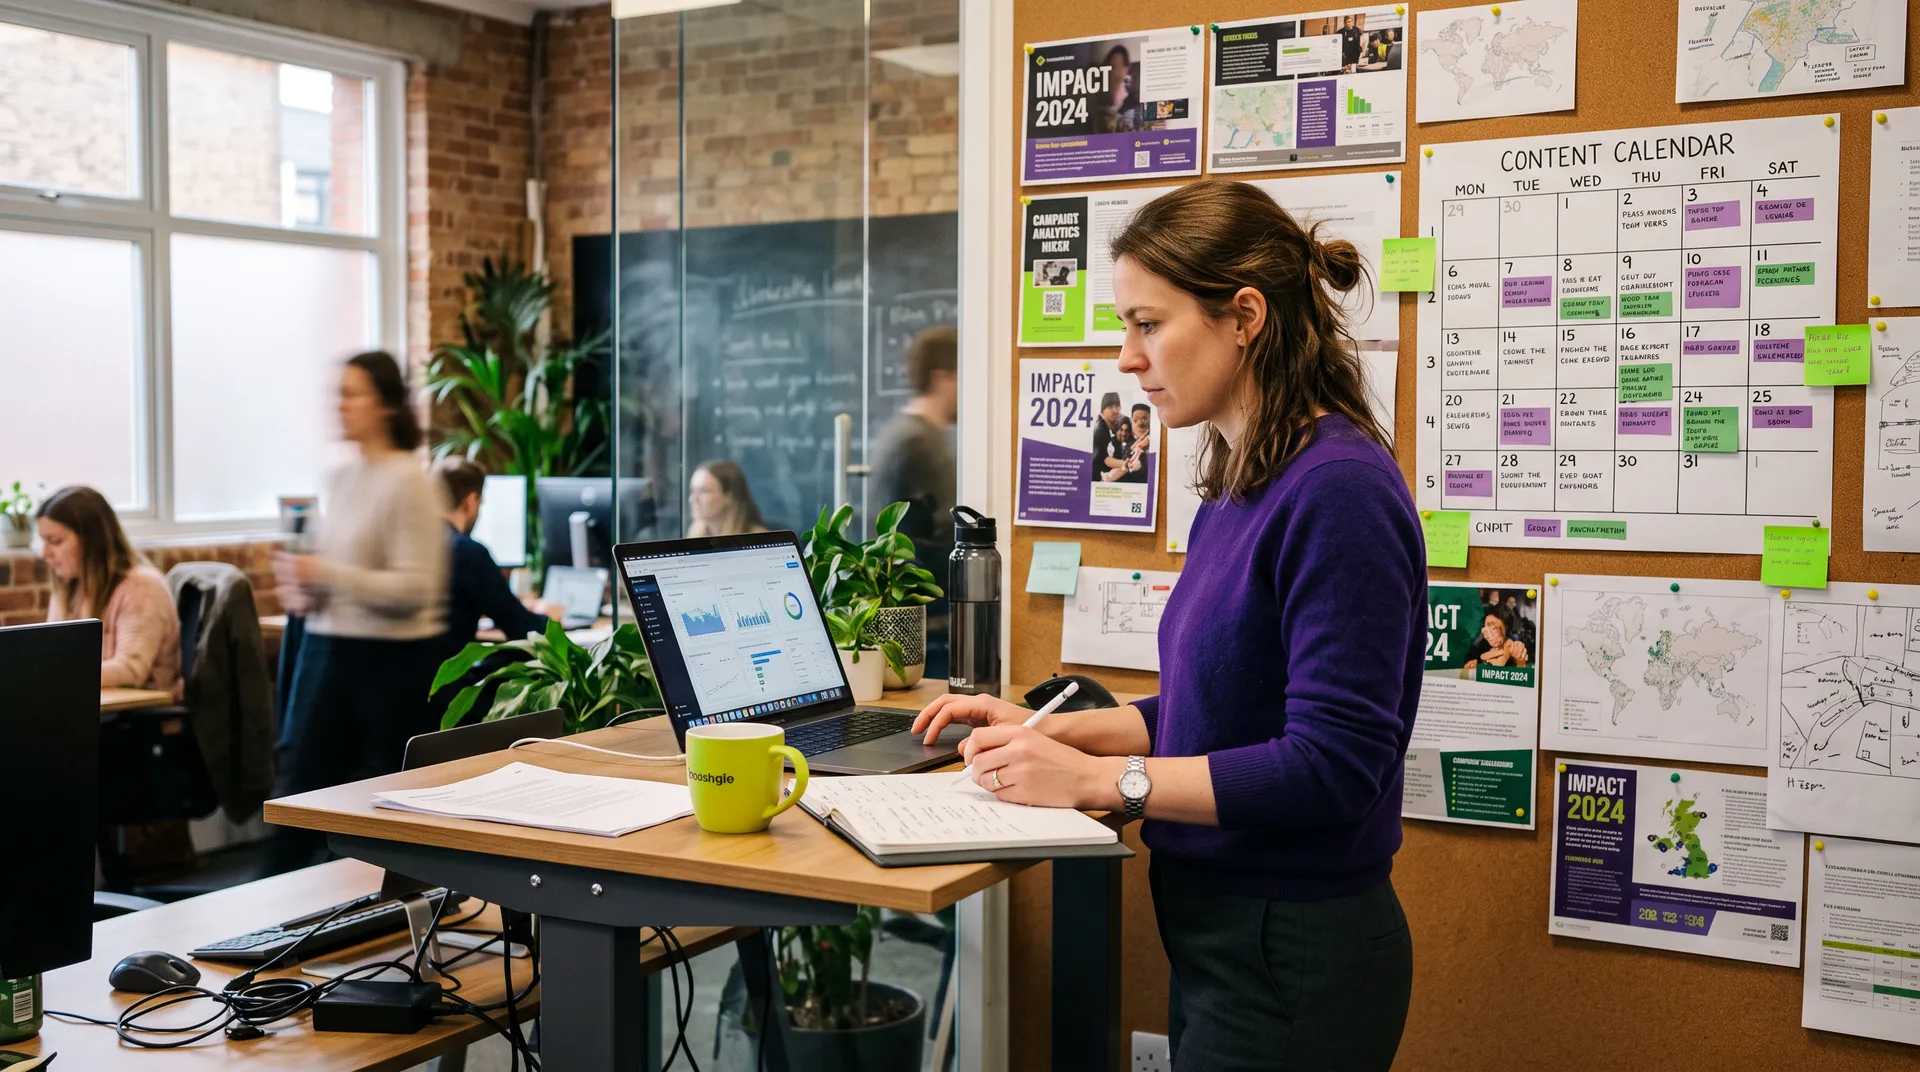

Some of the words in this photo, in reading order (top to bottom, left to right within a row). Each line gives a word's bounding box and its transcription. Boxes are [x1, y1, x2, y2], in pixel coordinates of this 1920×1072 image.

[1036, 66, 1112, 98] IMPACT
[1036, 98, 1088, 127] 2024
[1501, 143, 1602, 172] CONTENT
[1614, 132, 1735, 163] CALENDAR
[1455, 183, 1485, 196] MON
[1513, 178, 1540, 192] TUE
[1570, 175, 1601, 188] WED
[1632, 171, 1661, 183] THU
[1701, 166, 1725, 180] FRI
[1768, 160, 1798, 174] SAT
[1448, 204, 1464, 217] 29
[1503, 200, 1521, 213] 30
[1623, 192, 1633, 205] 2
[1687, 188, 1698, 202] 3
[1756, 184, 1768, 197] 4
[1033, 226, 1080, 240] ANALYTICS
[1448, 265, 1458, 277] 6
[1505, 262, 1513, 274] 7
[1563, 258, 1572, 271] 8
[1622, 255, 1632, 269] 9
[1687, 253, 1701, 265] 10
[1758, 250, 1767, 261] 11
[1428, 291, 1436, 303] 2
[1446, 332, 1460, 345] 13
[1503, 331, 1516, 343] 14
[1562, 329, 1575, 342] 15
[1621, 328, 1636, 339] 16
[1686, 326, 1700, 338] 17
[1755, 323, 1770, 336] 18
[1427, 356, 1436, 368] 3
[1031, 373, 1095, 393] IMPACT
[1445, 394, 1462, 406] 20
[1502, 394, 1514, 405] 21
[1560, 393, 1577, 404] 22
[1684, 391, 1703, 403] 24
[1753, 390, 1772, 403] 25
[1030, 398, 1093, 428] 2024
[1426, 416, 1435, 429] 4
[1445, 454, 1461, 466] 27
[1501, 454, 1518, 467] 28
[1559, 454, 1576, 467] 29
[1618, 455, 1637, 468] 30
[1684, 454, 1698, 468] 31
[1426, 475, 1435, 488] 5
[1482, 669, 1508, 680] IMPACT
[1510, 672, 1528, 681] 2024
[1568, 774, 1627, 796] IMPACT
[1567, 794, 1625, 824] 2024
